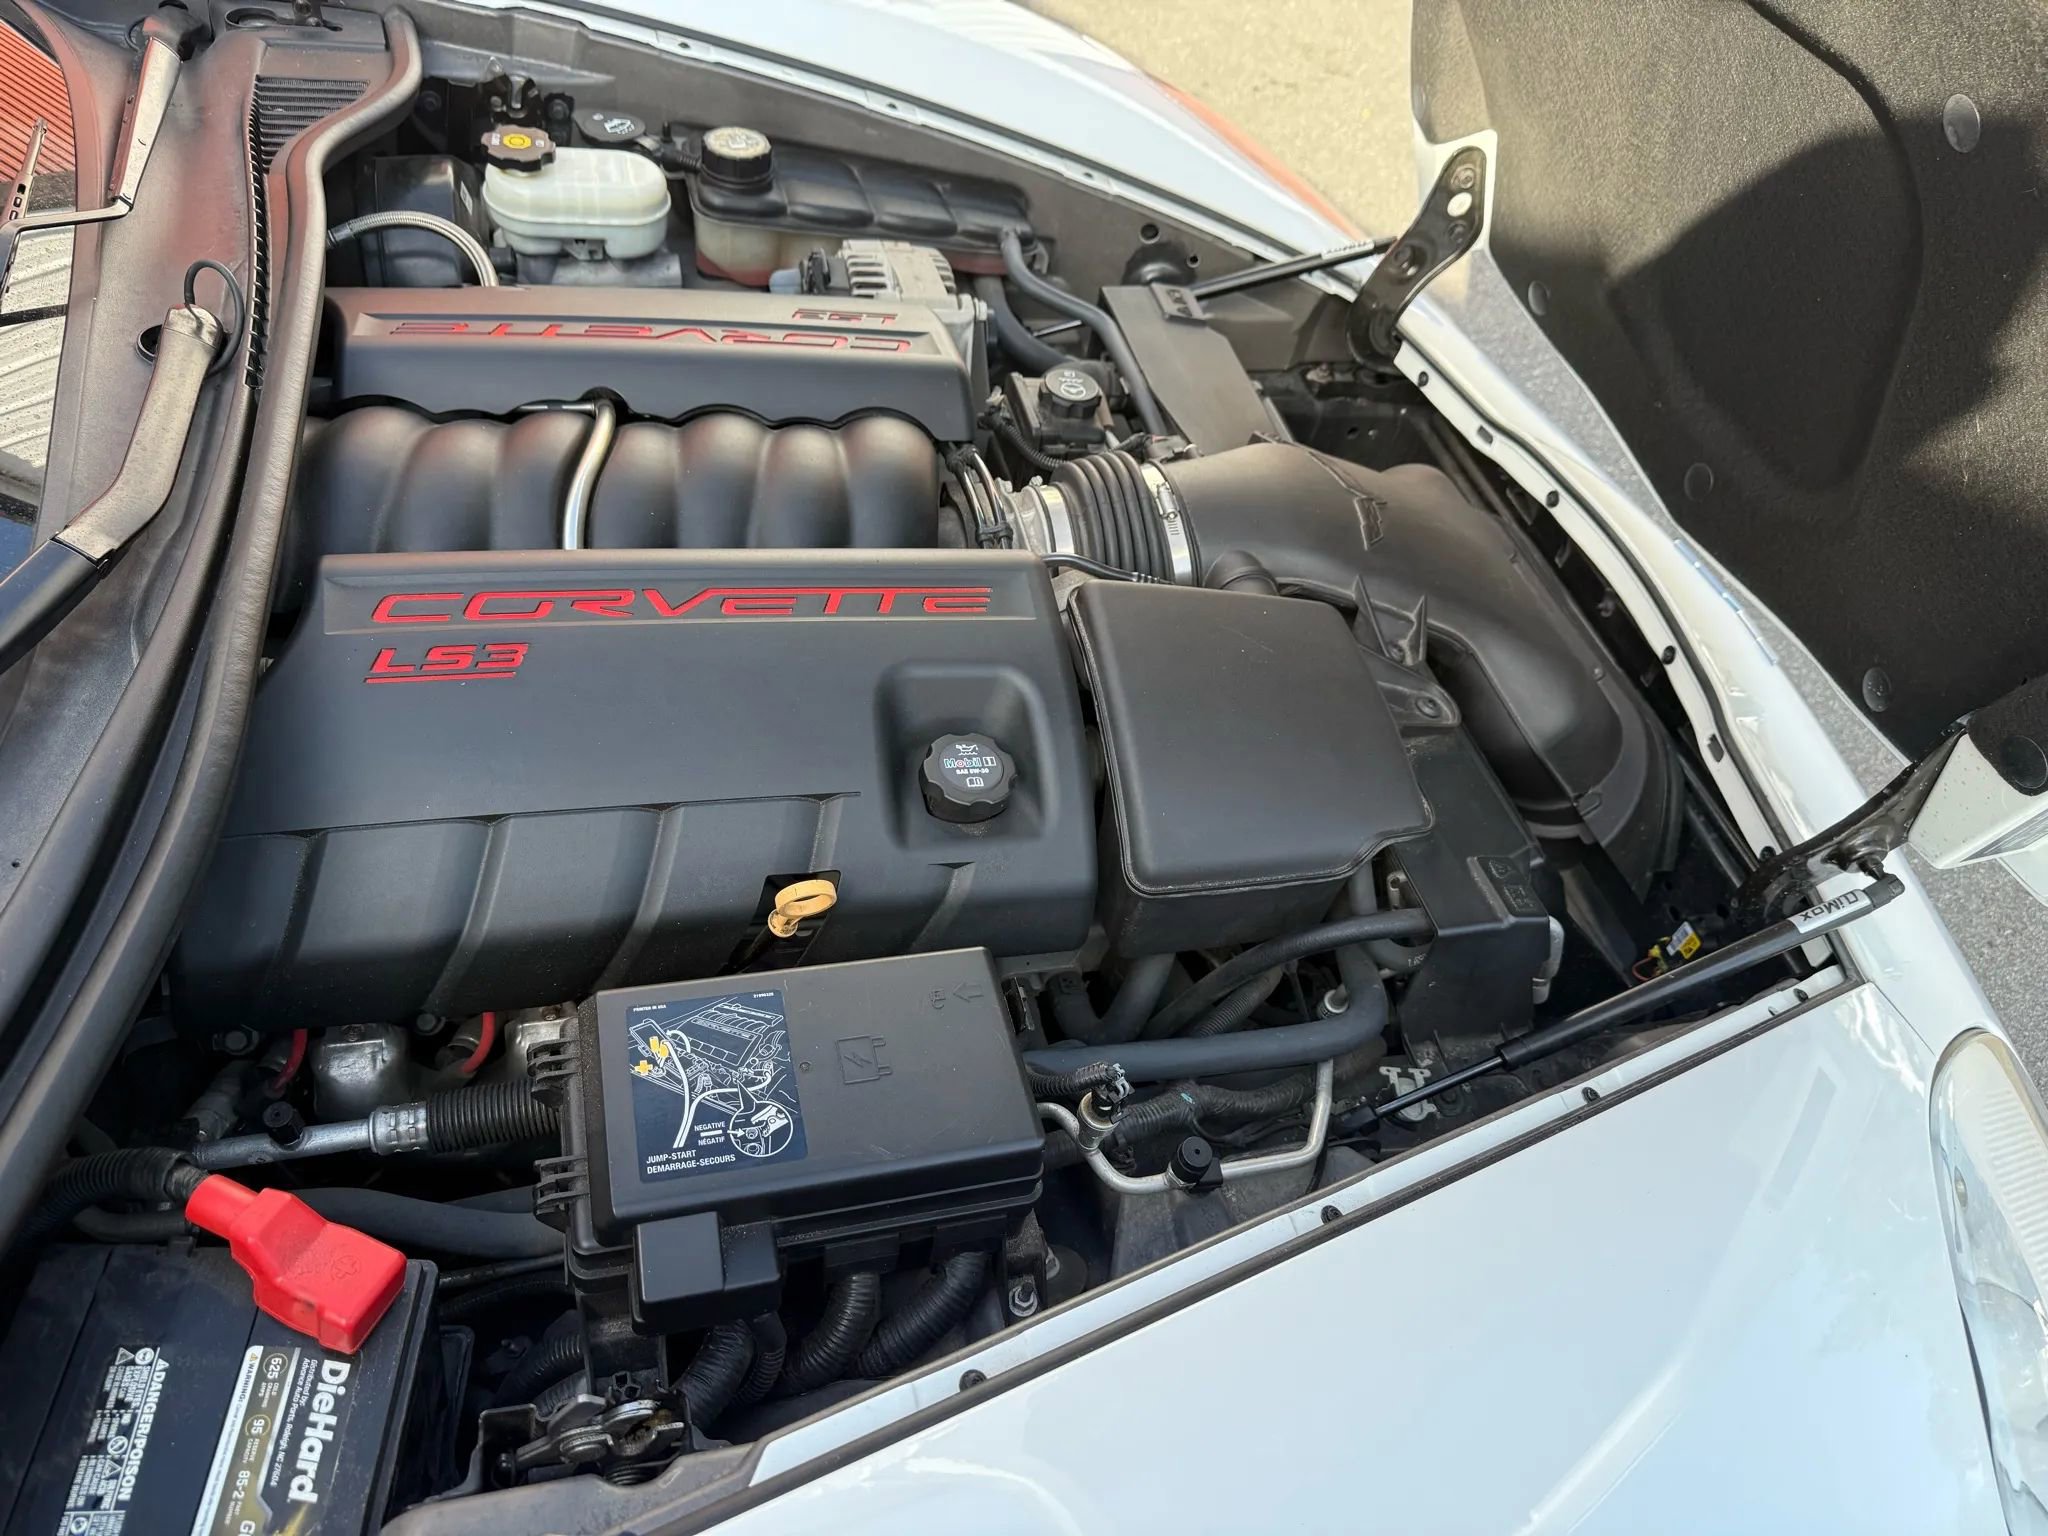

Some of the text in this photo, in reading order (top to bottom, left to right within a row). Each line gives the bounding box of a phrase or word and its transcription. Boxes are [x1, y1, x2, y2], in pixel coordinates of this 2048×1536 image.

[792, 308, 898, 325] LS3
[389, 321, 911, 353] CORVETTE
[370, 586, 992, 623] CORVETTE
[369, 642, 530, 673] LS3
[943, 757, 982, 768] Mobil
[694, 1121, 726, 1132] NEGATIVE
[698, 1136, 725, 1146] NÉGATIF
[646, 1150, 697, 1164] JUMP-START
[647, 1154, 736, 1174] DEMARRAGE-SECOURS
[267, 1357, 282, 1379] 625
[297, 1357, 311, 1386] Advance
[302, 1359, 318, 1396] Distributed
[238, 1363, 255, 1402] WARNING:
[271, 1382, 280, 1396] COLD
[292, 1386, 303, 1403] Auto
[286, 1402, 299, 1423] Parts,
[117, 1371, 166, 1500] DANGER/POISON
[251, 1419, 265, 1434] 95
[289, 1359, 351, 1504] DieHard
[276, 1451, 285, 1462] NC
[232, 1470, 251, 1499] 85-2
